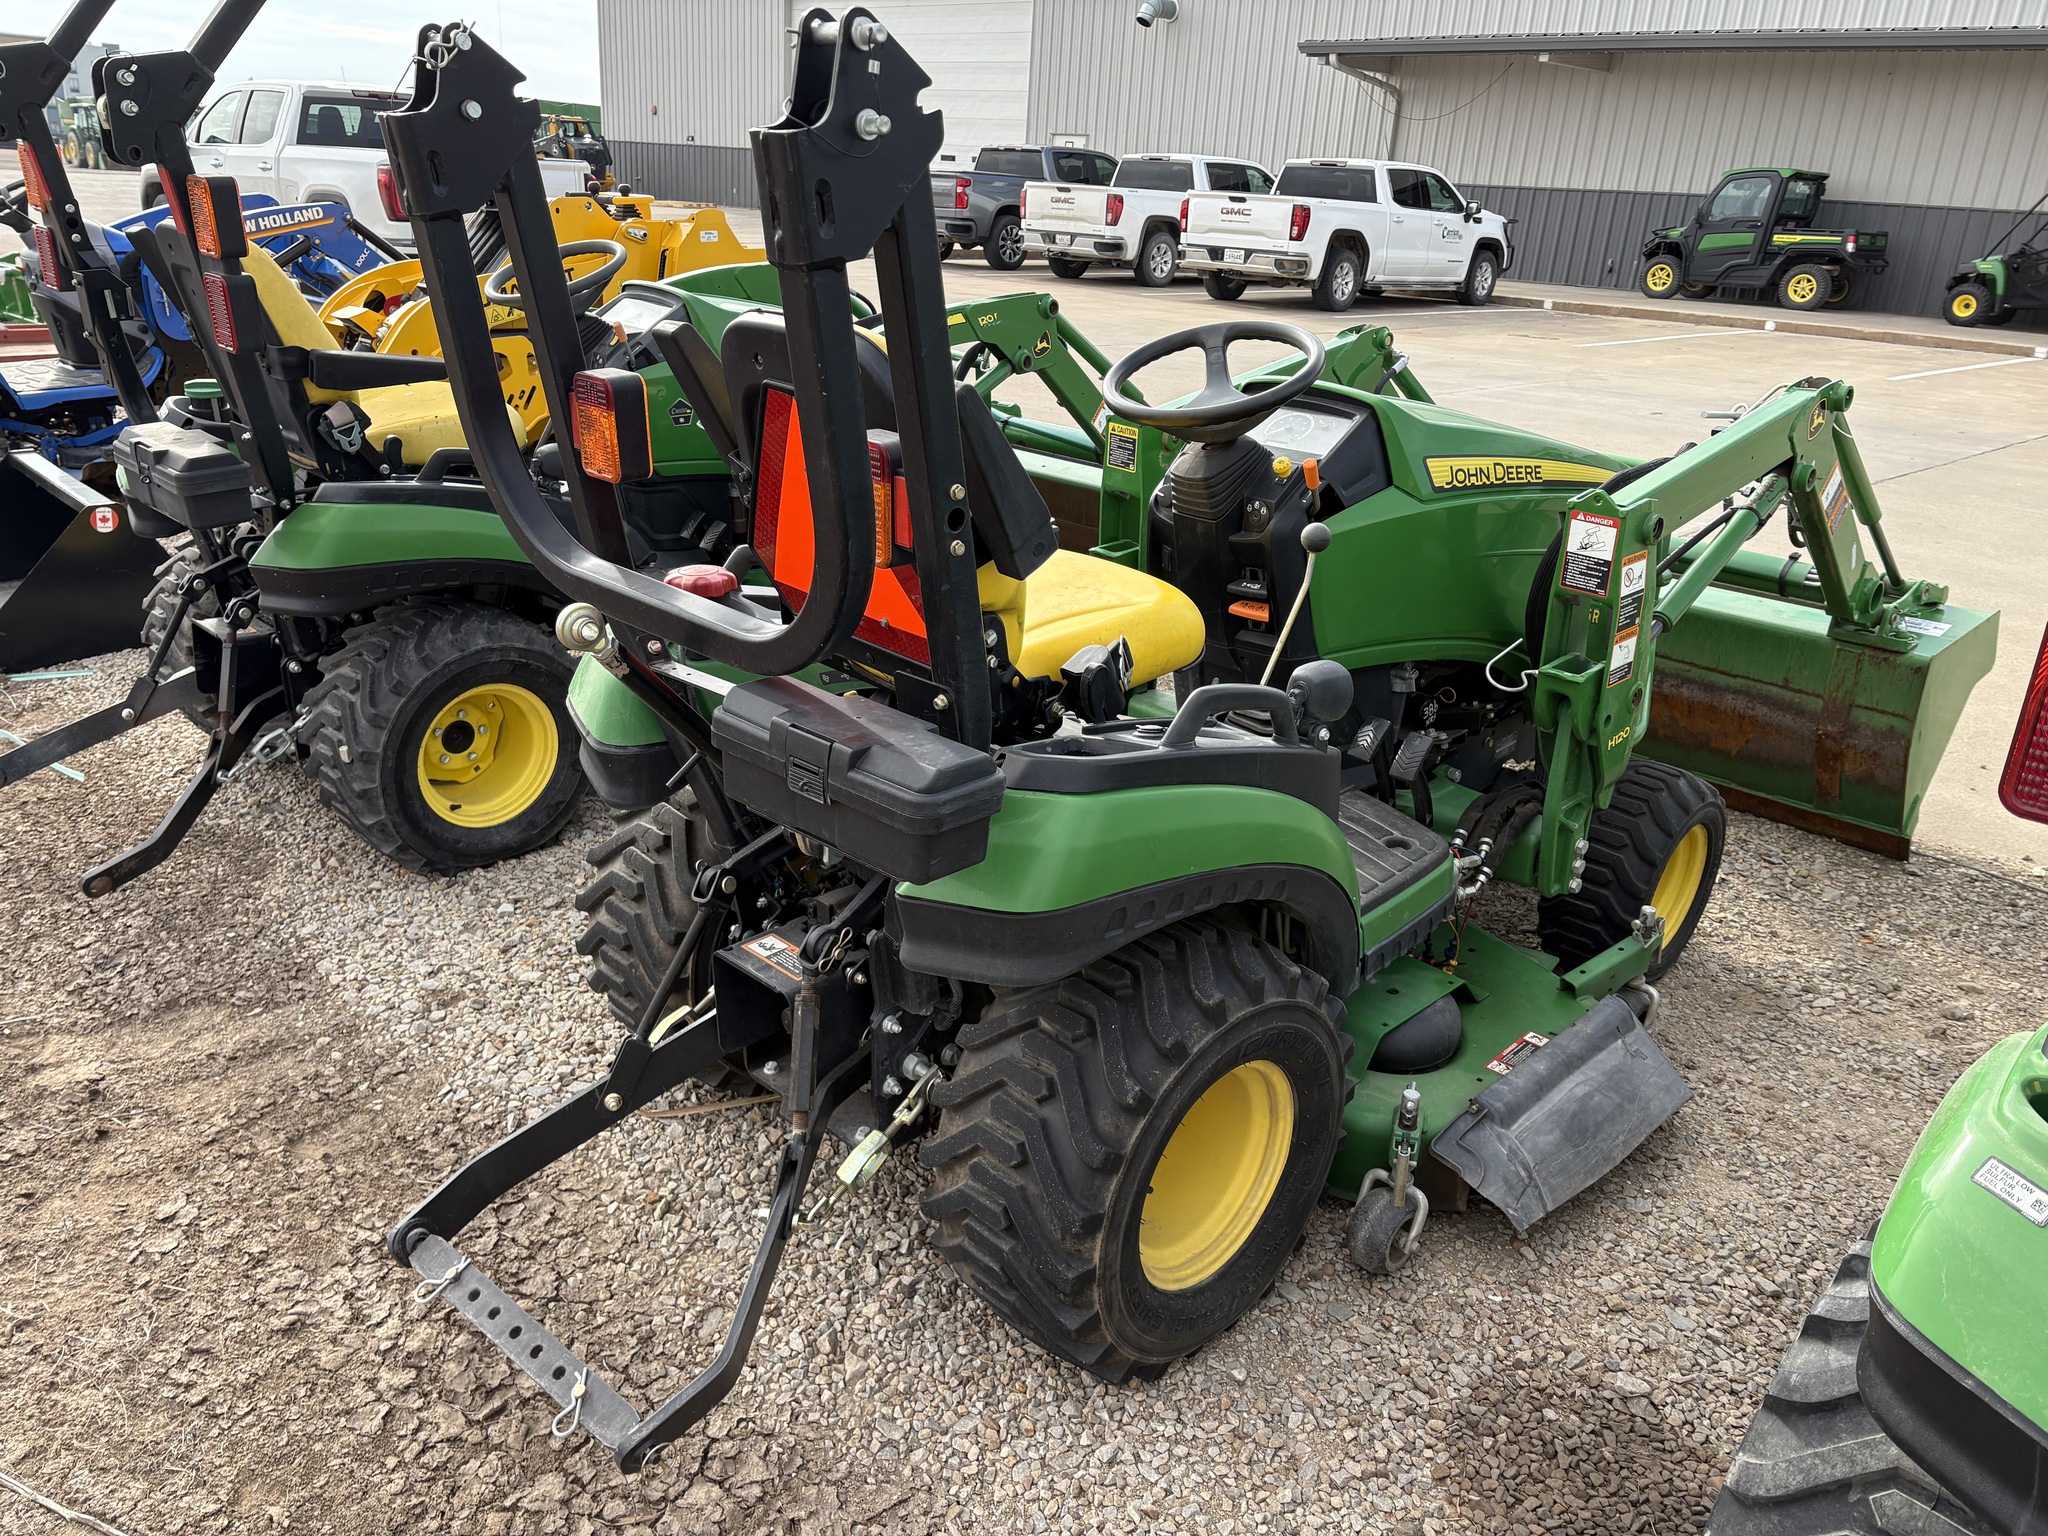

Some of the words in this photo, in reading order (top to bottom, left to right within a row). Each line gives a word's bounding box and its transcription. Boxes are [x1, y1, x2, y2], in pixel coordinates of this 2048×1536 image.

[1050, 196, 1075, 205] GMC
[258, 206, 324, 230] HOLLAND
[1221, 207, 1252, 217] GMC
[1117, 426, 1137, 437] CAUTION
[1444, 465, 1491, 486] JOHN
[1493, 462, 1543, 481] DEERE
[1585, 515, 1614, 527] DANGER
[1626, 551, 1647, 565] WARNING
[1619, 629, 1638, 641] WARNING
[1607, 726, 1631, 751] H120
[1984, 1168, 2016, 1191] SULFUR
[1989, 1162, 2015, 1182] ULTRA
[2015, 1179, 2036, 1195] LOW
[1979, 1173, 1998, 1189] FUEL
[1999, 1186, 2023, 1203] ONLY
